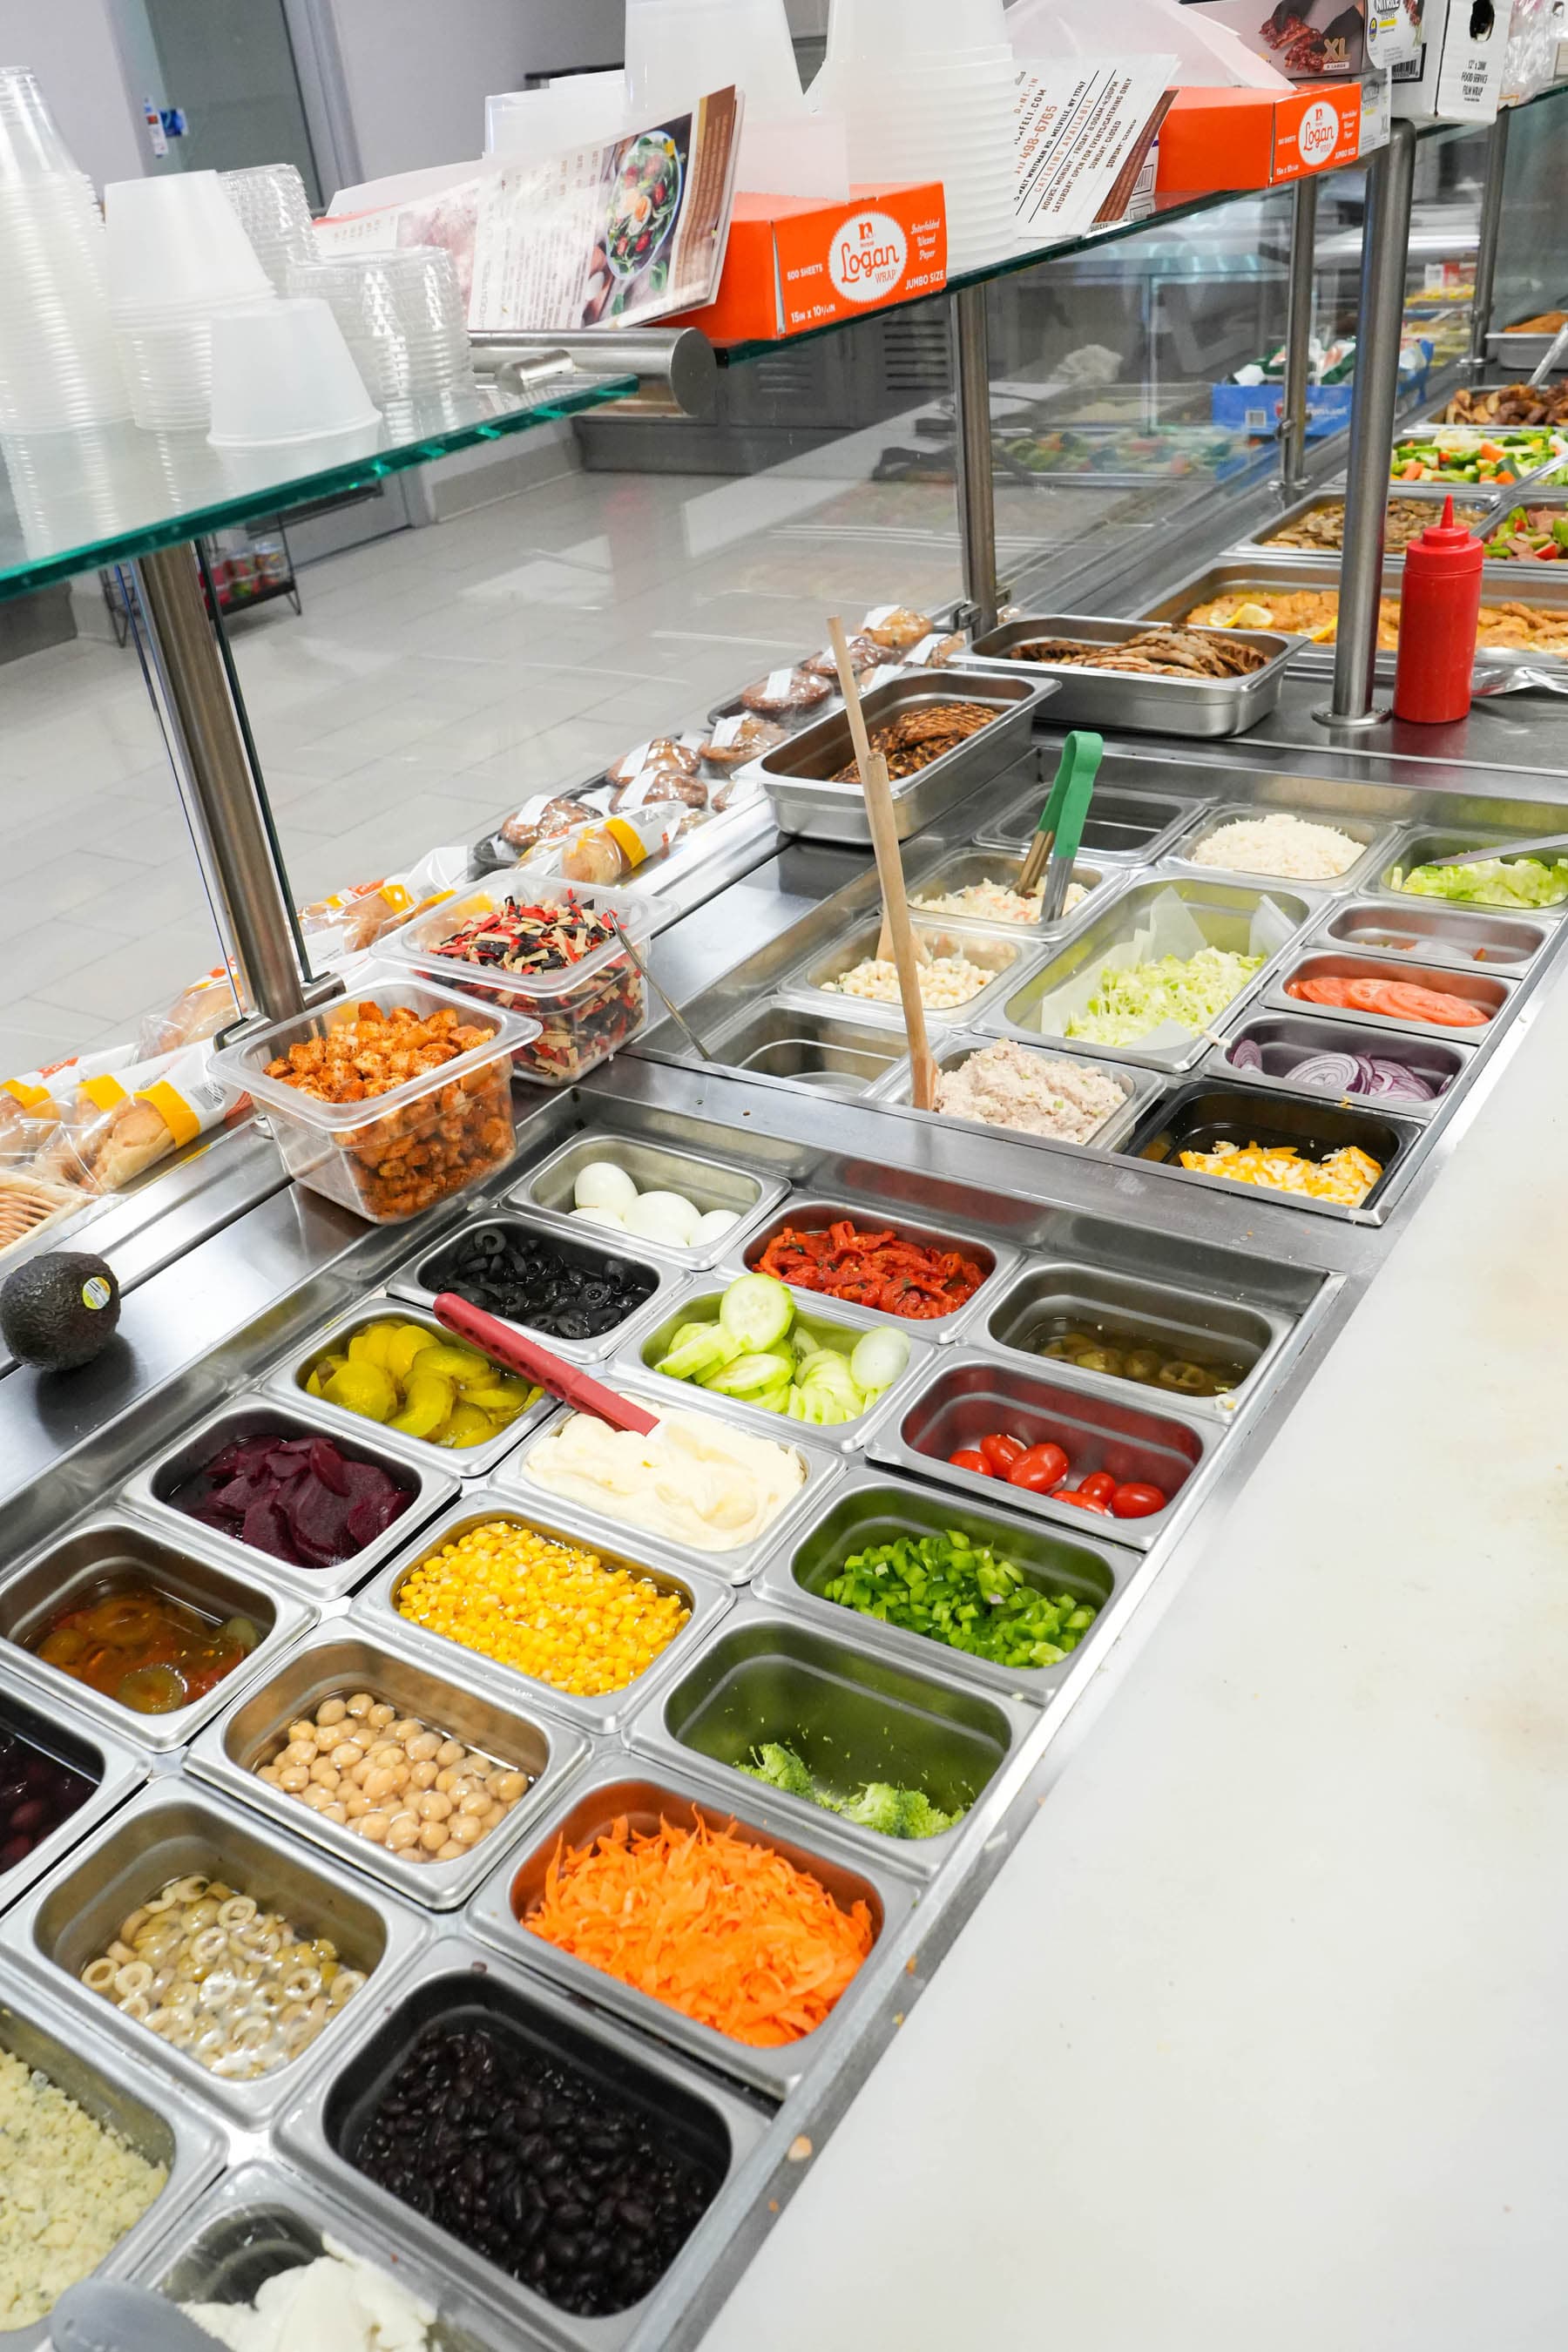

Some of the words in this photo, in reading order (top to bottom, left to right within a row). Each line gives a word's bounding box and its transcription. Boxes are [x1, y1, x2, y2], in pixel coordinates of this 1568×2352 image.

[1323, 37, 1350, 63] XL
[1462, 71, 1473, 83] FOOD
[1473, 73, 1488, 84] SERVICE
[1463, 84, 1472, 95] FILM
[1472, 85, 1484, 97] WRAP
[1019, 105, 1058, 158] 498-6765
[1027, 151, 1047, 178] WHITMAN
[1044, 139, 1054, 148] RD.
[1051, 109, 1071, 137] MELVILLE,
[1072, 82, 1086, 97] 11747
[1304, 122, 1335, 152] Logan
[1034, 151, 1064, 192] CATERING
[1062, 98, 1094, 145] AVAILABLE
[1051, 179, 1075, 213] SATURDAY:
[1071, 162, 1085, 177] OPEN
[1081, 150, 1092, 160] FOR
[1090, 96, 1124, 147] EVENTS/CATERING
[1119, 78, 1132, 93] ONLY
[1088, 145, 1108, 169] SUNDAY:
[1105, 121, 1122, 142] CLOSED
[1105, 141, 1125, 168] SUNDAY:
[1042, 186, 1058, 210] HOURS:
[1054, 161, 1074, 186] MONDAY
[1073, 132, 1092, 153] FRIDAY:
[911, 219, 940, 234] Interfolded
[917, 233, 936, 247] Waxed
[841, 241, 900, 283] Logan
[919, 249, 936, 260] Paper
[787, 270, 800, 281] 500
[800, 263, 823, 278] SHEETS
[875, 268, 897, 283] WRAP
[905, 274, 929, 291] JUMBO
[929, 270, 944, 283] SIZE
